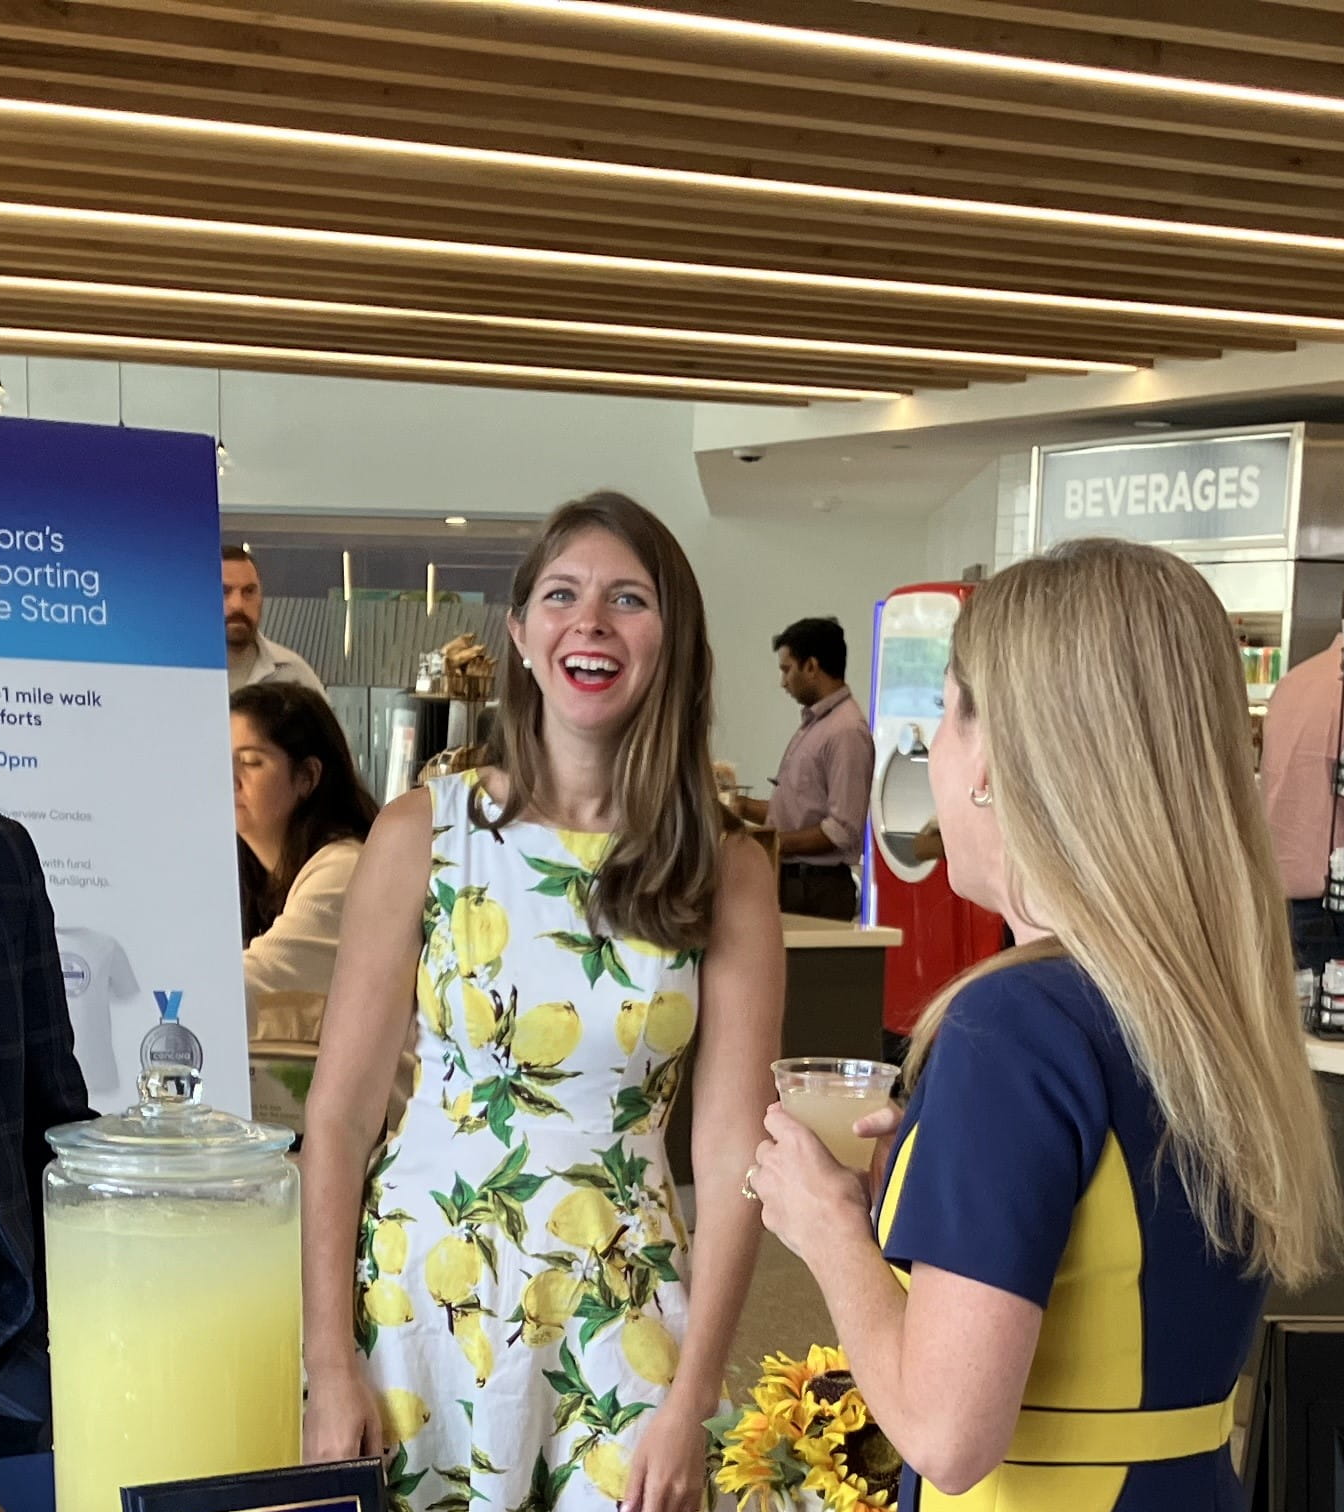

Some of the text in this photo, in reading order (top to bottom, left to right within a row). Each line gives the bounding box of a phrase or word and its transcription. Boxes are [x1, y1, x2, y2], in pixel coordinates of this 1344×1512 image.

[1064, 465, 1260, 520] BEVERAGES
[21, 594, 106, 626] Stand
[16, 688, 54, 705] mile
[59, 690, 102, 708] walk
[49, 810, 92, 822] Condos
